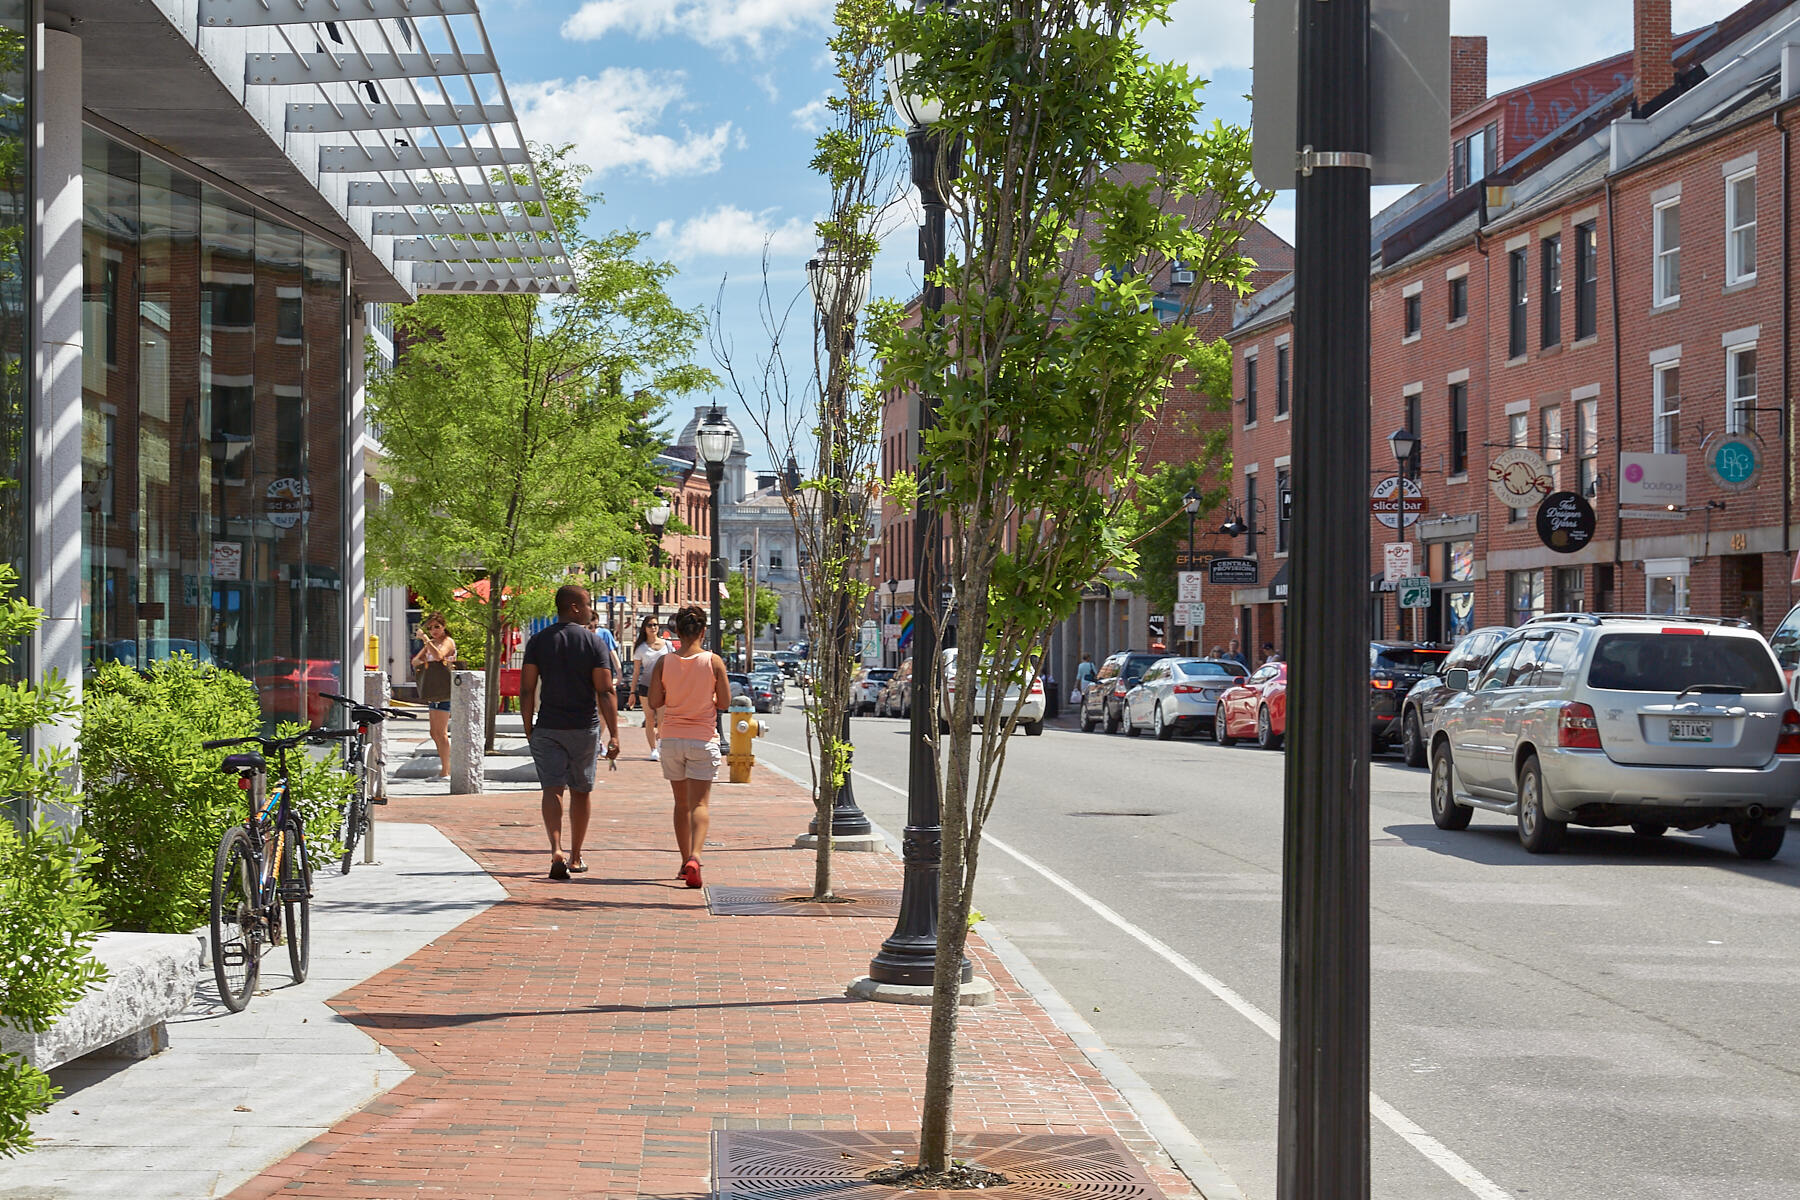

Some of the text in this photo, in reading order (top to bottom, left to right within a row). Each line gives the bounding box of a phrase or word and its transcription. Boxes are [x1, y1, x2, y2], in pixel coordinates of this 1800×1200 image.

[1377, 480, 1393, 495] OLD
[1373, 501, 1422, 510] slice bar
[1150, 615, 1165, 623] ATM
